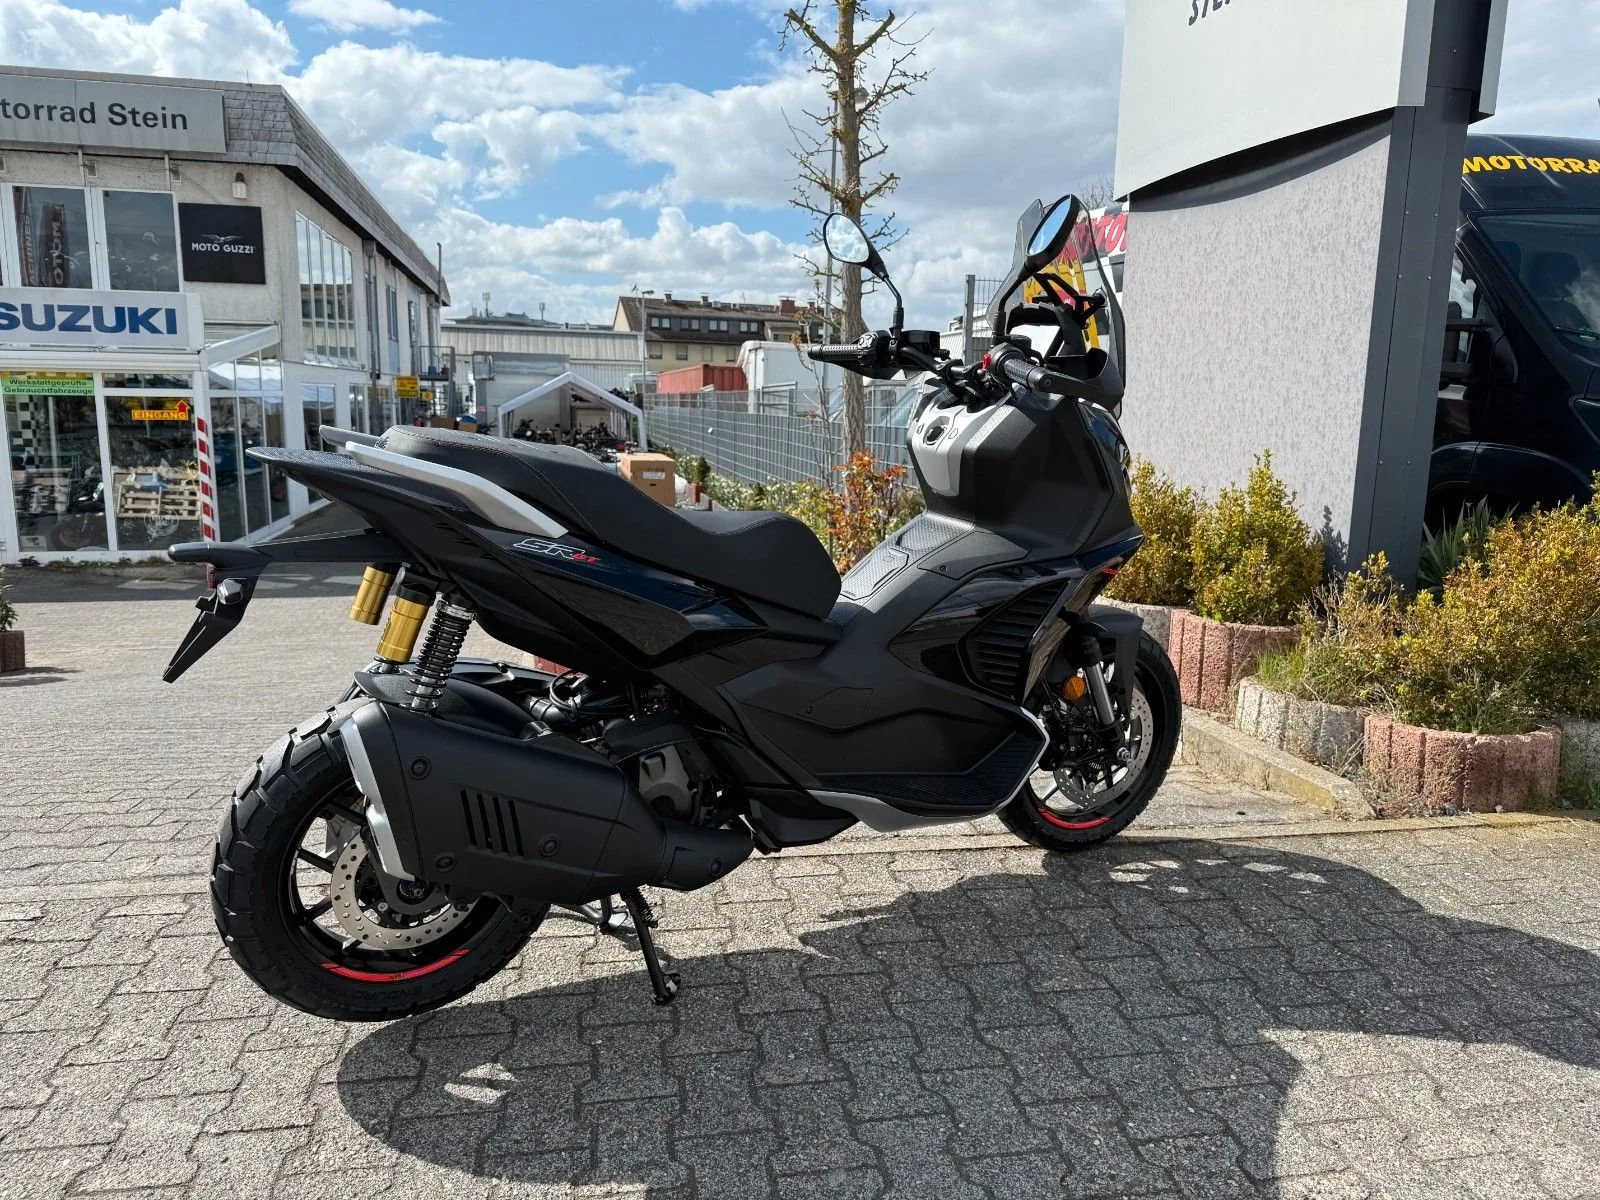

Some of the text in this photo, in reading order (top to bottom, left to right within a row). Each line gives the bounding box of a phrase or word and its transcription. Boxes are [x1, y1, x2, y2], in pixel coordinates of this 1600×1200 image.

[0, 98, 188, 130] torrad Stein
[191, 242, 254, 254] MOTO GUZZI
[0, 302, 178, 335] SUZUKI
[9, 379, 87, 387] Werkstattgeprüfte
[4, 386, 93, 395] Gebrauchtfahrzeuge
[134, 411, 186, 420] EINGANG
[513, 538, 586, 560] SR
